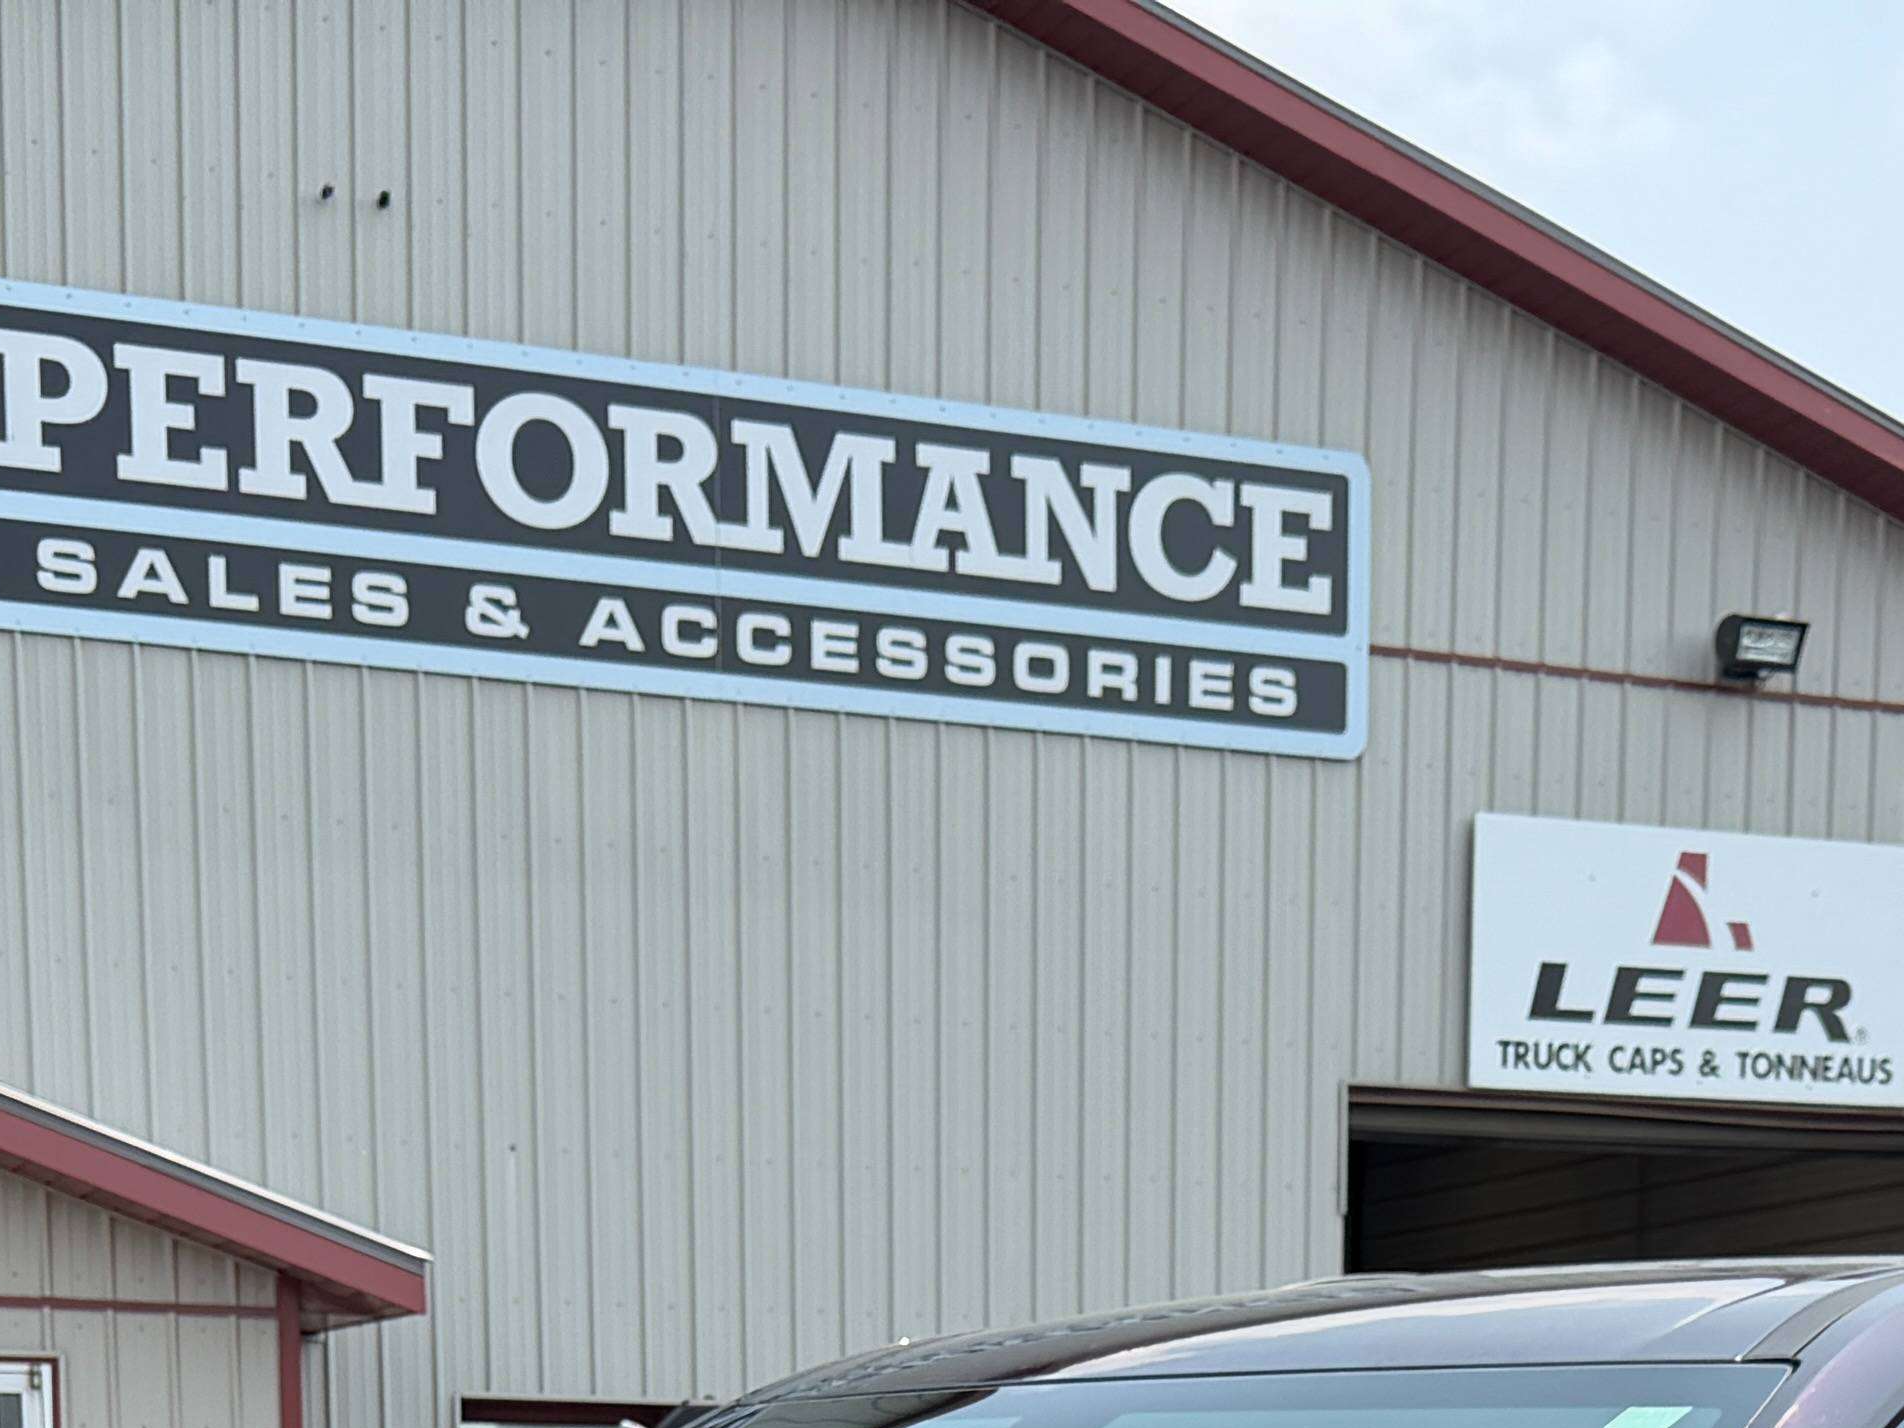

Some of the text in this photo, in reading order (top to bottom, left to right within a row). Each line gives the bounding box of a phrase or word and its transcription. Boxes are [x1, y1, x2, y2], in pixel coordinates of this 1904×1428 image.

[36, 537, 1300, 718] SALES & ACCESSORIES
[1527, 962, 1853, 1044] LEER
[1497, 1040, 1893, 1086] TRUCK CAPS & TONNEAUS
